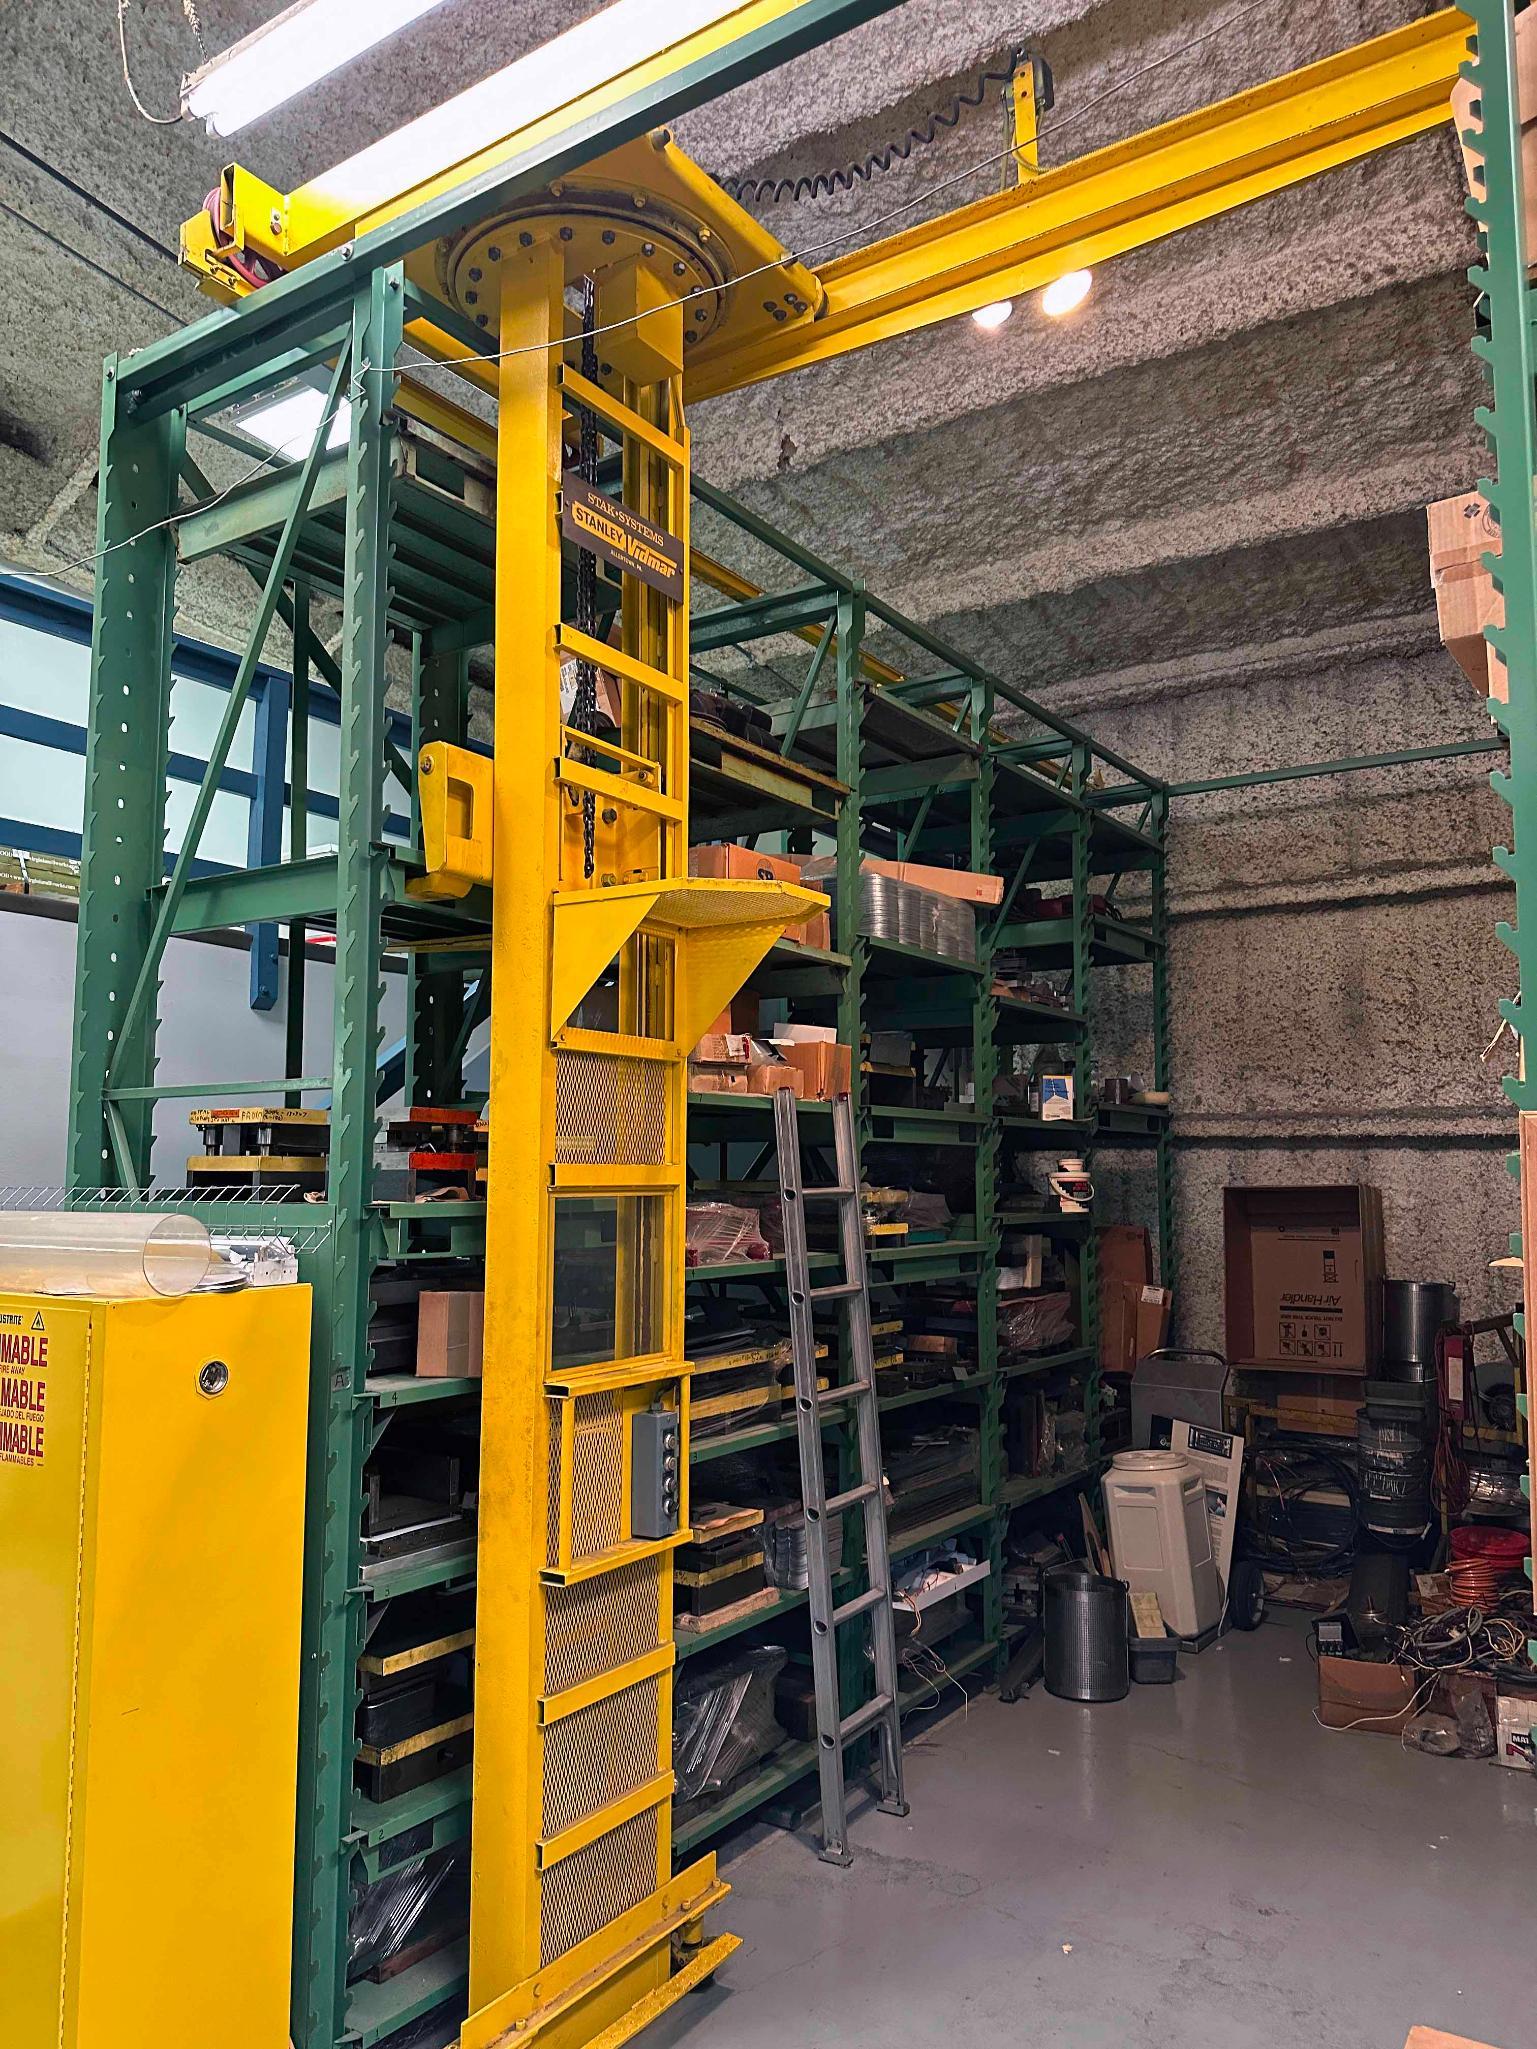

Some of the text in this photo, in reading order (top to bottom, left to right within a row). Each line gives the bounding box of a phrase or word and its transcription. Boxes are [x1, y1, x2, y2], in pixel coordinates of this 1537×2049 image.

[576, 507, 677, 579] STANLEY Vidmar
[0, 1333, 48, 1367] MABLE
[391, 1391, 399, 1405] 4
[26, 1412, 44, 1423] FUEGO
[378, 1828, 385, 1840] 2
